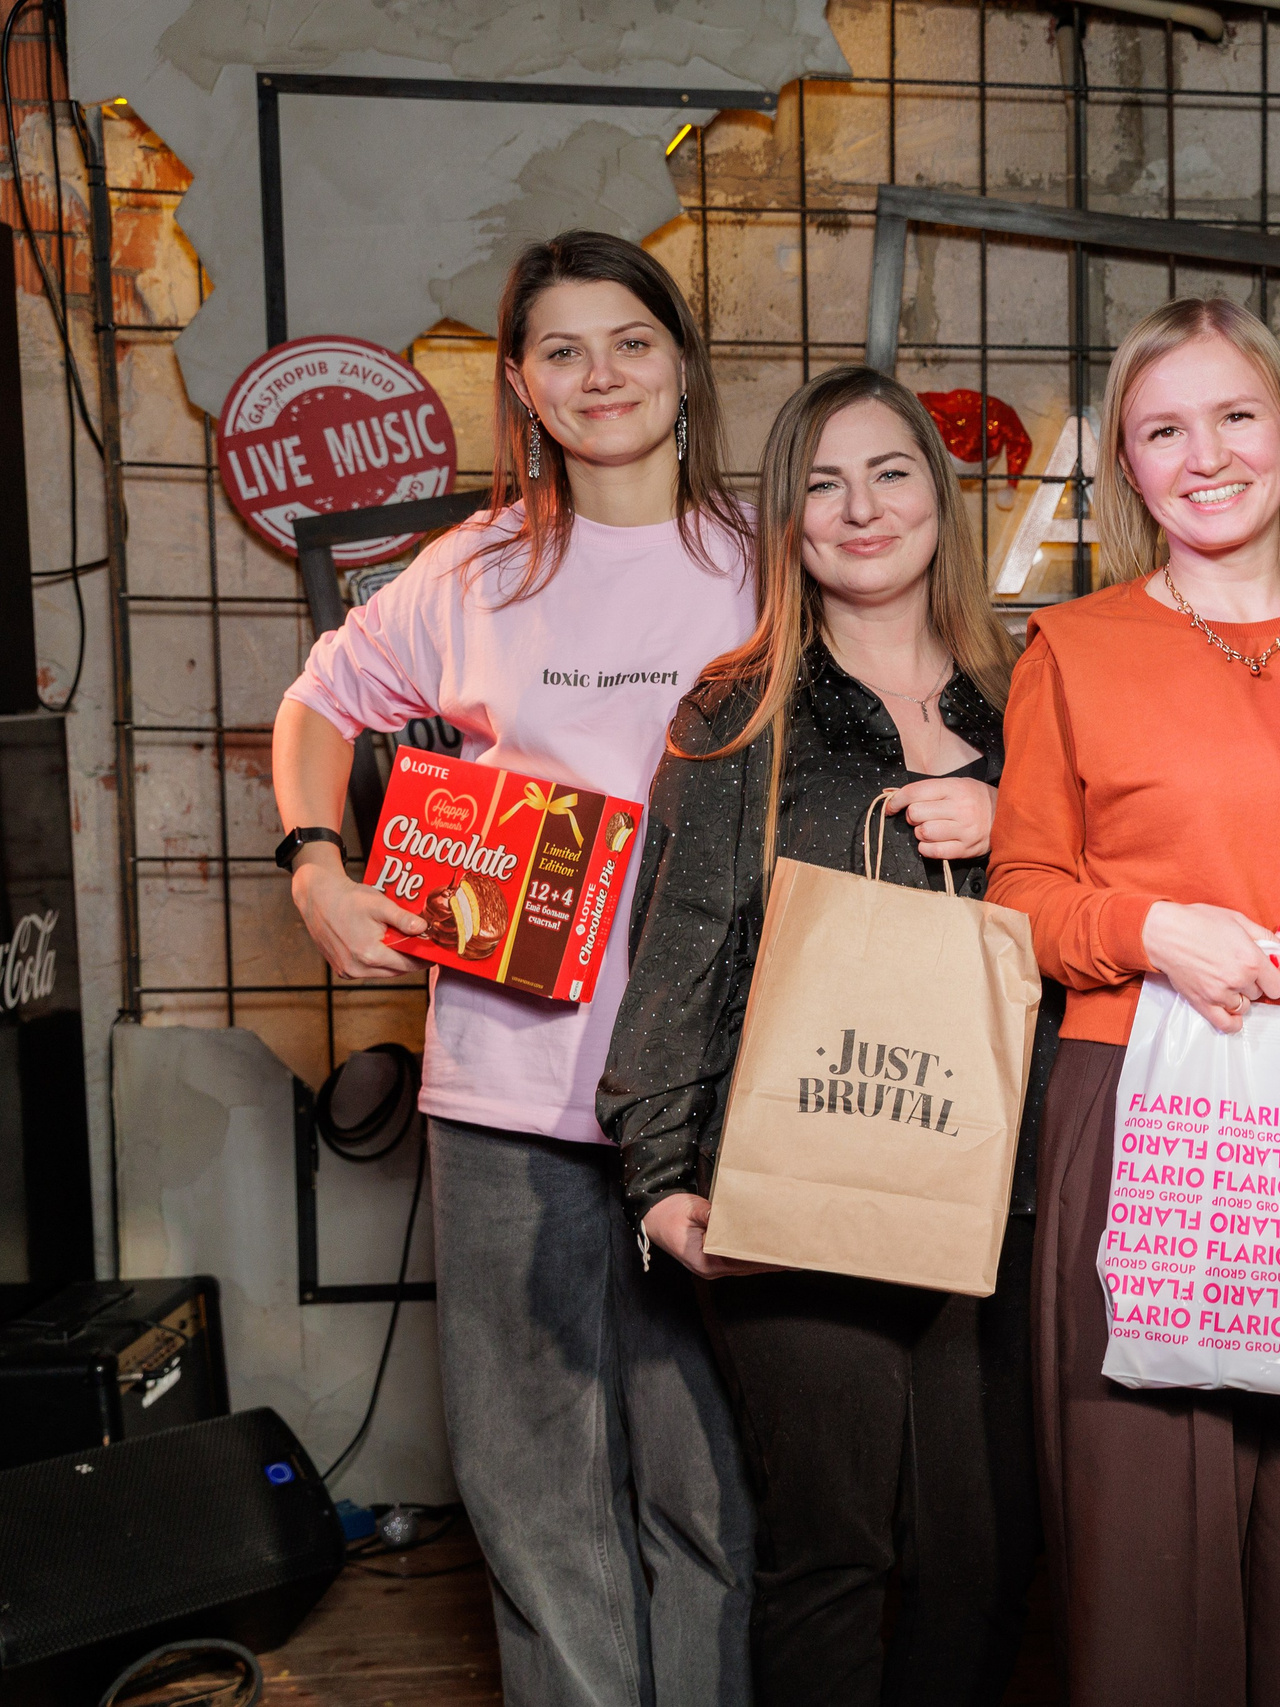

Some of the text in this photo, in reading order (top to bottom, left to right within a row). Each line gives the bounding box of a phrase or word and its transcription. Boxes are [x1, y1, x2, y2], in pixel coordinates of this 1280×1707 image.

[250, 361, 396, 424] GASTROPUB ZAVOD
[227, 403, 447, 500] LIVE MUSIC
[542, 668, 679, 688] toxic introvert
[411, 760, 450, 781] LOTTE
[432, 798, 470, 821] Happy
[430, 817, 463, 832] Moments
[382, 814, 519, 882] Chocolate
[543, 841, 583, 863] Limited
[372, 854, 425, 902] Pie
[525, 900, 570, 921] Ещё больше
[578, 859, 616, 966] Chocolate Pie
[580, 882, 597, 923] LOTTE
[527, 915, 561, 931] счастья!
[828, 1028, 940, 1088] JUST
[797, 1077, 960, 1137] BRUTAL
[1129, 1093, 1211, 1118] FLARIO
[1125, 1118, 1162, 1129] GROUP
[1167, 1121, 1209, 1133] GROUP
[1218, 1126, 1254, 1140] GROUP
[1122, 1133, 1208, 1160] FLARIO
[1117, 1161, 1204, 1188] FLARIO
[1114, 1187, 1154, 1200] GROUP
[1159, 1191, 1202, 1204] GROUP
[1212, 1197, 1252, 1209] GROUP
[1111, 1202, 1201, 1230] FLARIO
[1107, 1230, 1198, 1258] FLARIO
[1105, 1257, 1147, 1270] GROUP
[1152, 1261, 1196, 1274] GROUP
[1205, 1267, 1246, 1280] GROUP
[1105, 1273, 1194, 1301] FLARIO
[1113, 1302, 1190, 1329] LARIO
[1145, 1331, 1188, 1344] GROUP
[1198, 1338, 1240, 1350] GROUP
